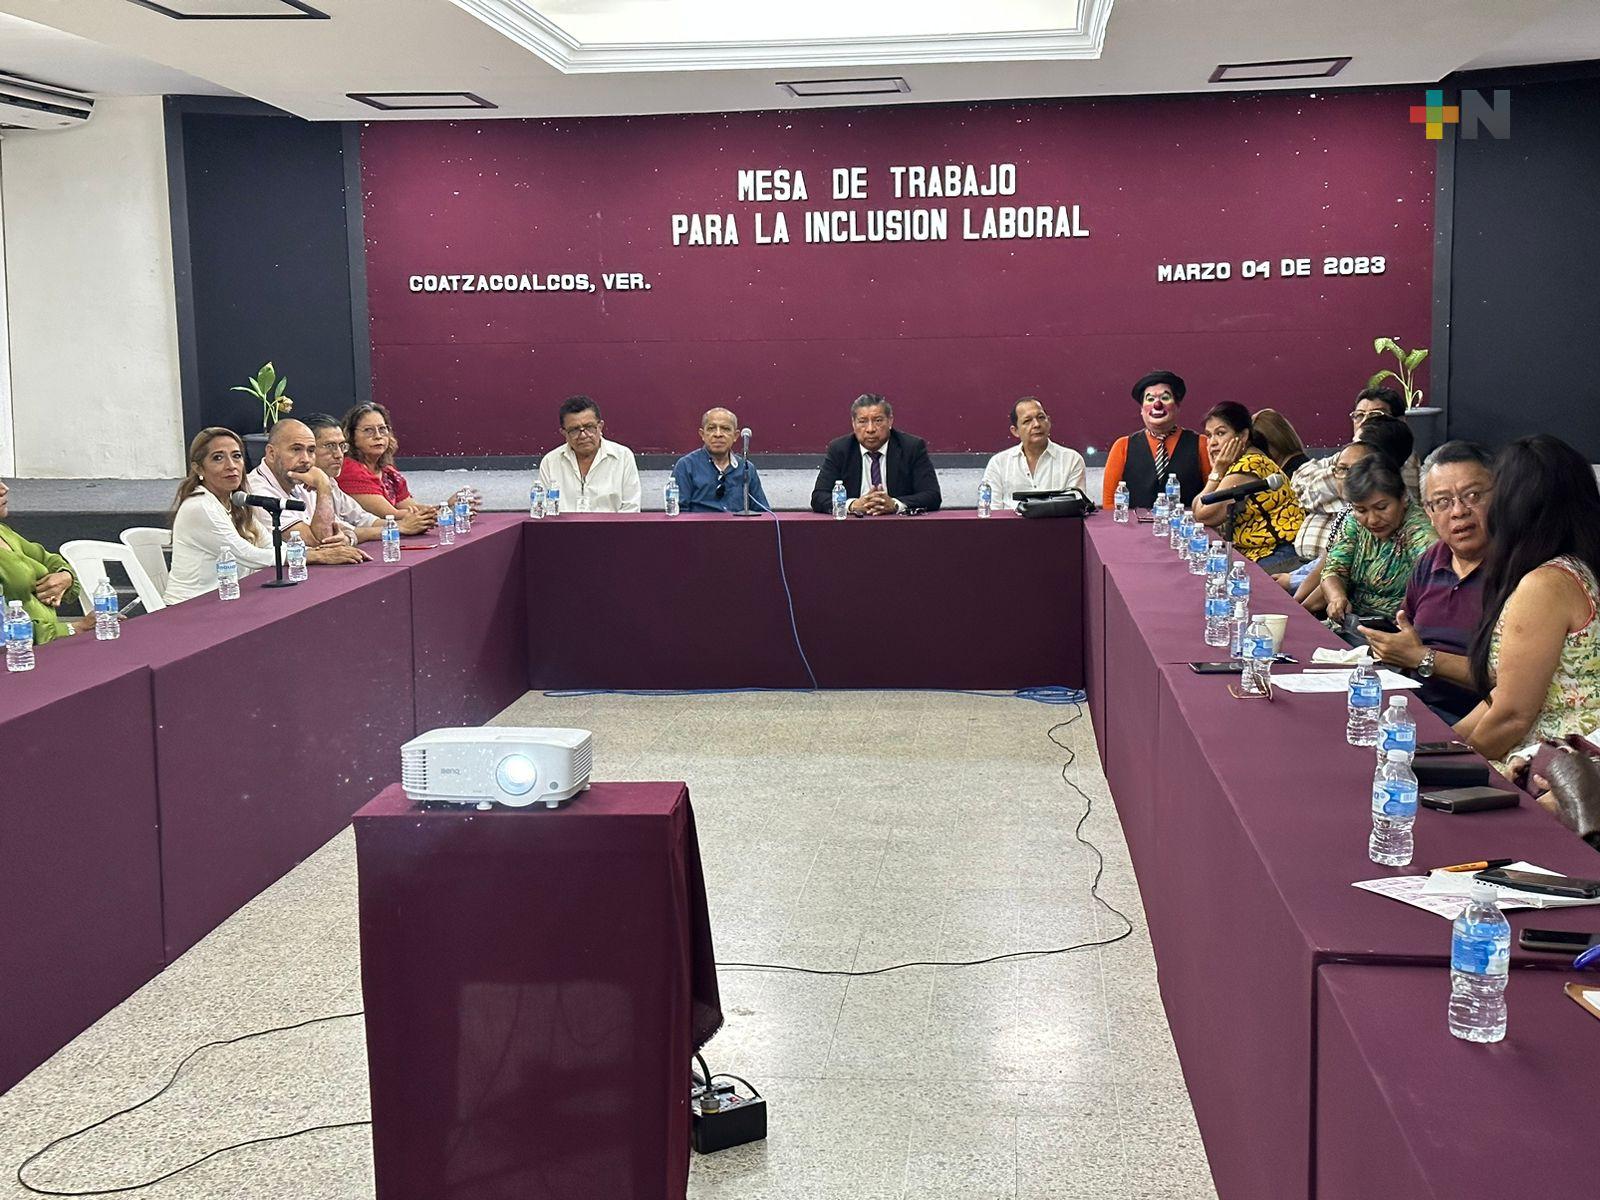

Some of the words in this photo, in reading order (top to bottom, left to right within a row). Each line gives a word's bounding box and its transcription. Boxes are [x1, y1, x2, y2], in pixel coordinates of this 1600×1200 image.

[738, 169, 808, 201] MESA
[832, 167, 867, 200] DE
[889, 163, 1016, 198] TRABAJO
[671, 213, 739, 246] PARA
[754, 211, 790, 244] LA
[805, 208, 947, 243] INCLUSION
[963, 204, 1090, 240] LABORAL
[409, 273, 596, 293] COATZACOALCOS,
[601, 272, 651, 290] VER.
[1157, 262, 1231, 282] MARZO
[1241, 260, 1270, 278] 04
[1280, 258, 1311, 277] DE
[1323, 256, 1386, 275] 2023
